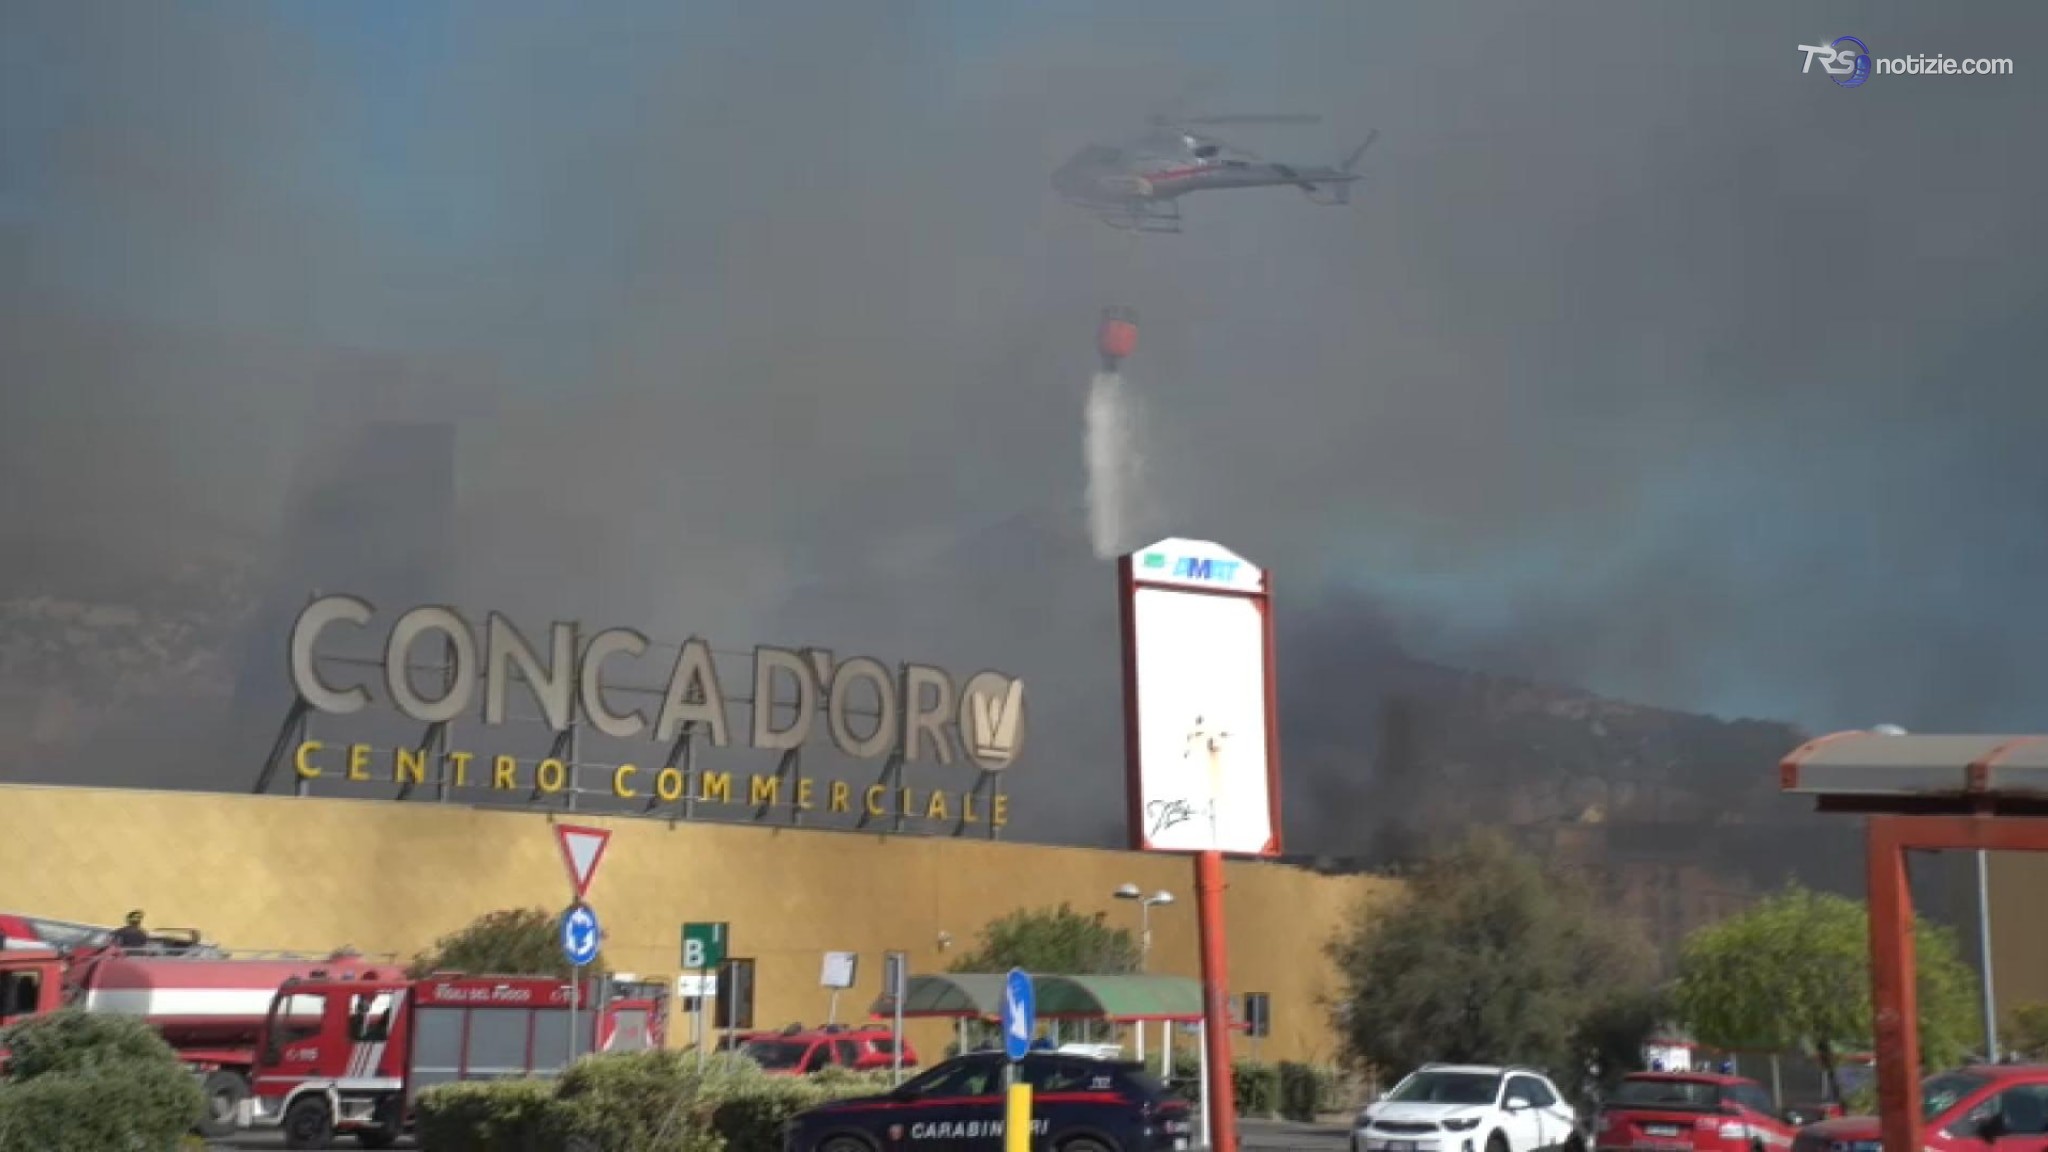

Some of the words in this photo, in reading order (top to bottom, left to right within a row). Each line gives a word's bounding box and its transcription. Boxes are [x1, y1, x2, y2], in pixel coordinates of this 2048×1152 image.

[289, 593, 731, 747] CONCA
[295, 740, 568, 794] CENTRO
[612, 763, 1010, 826] COMMERCIALE
[684, 938, 706, 967] B
[911, 1118, 1051, 1139] CARABINRI
